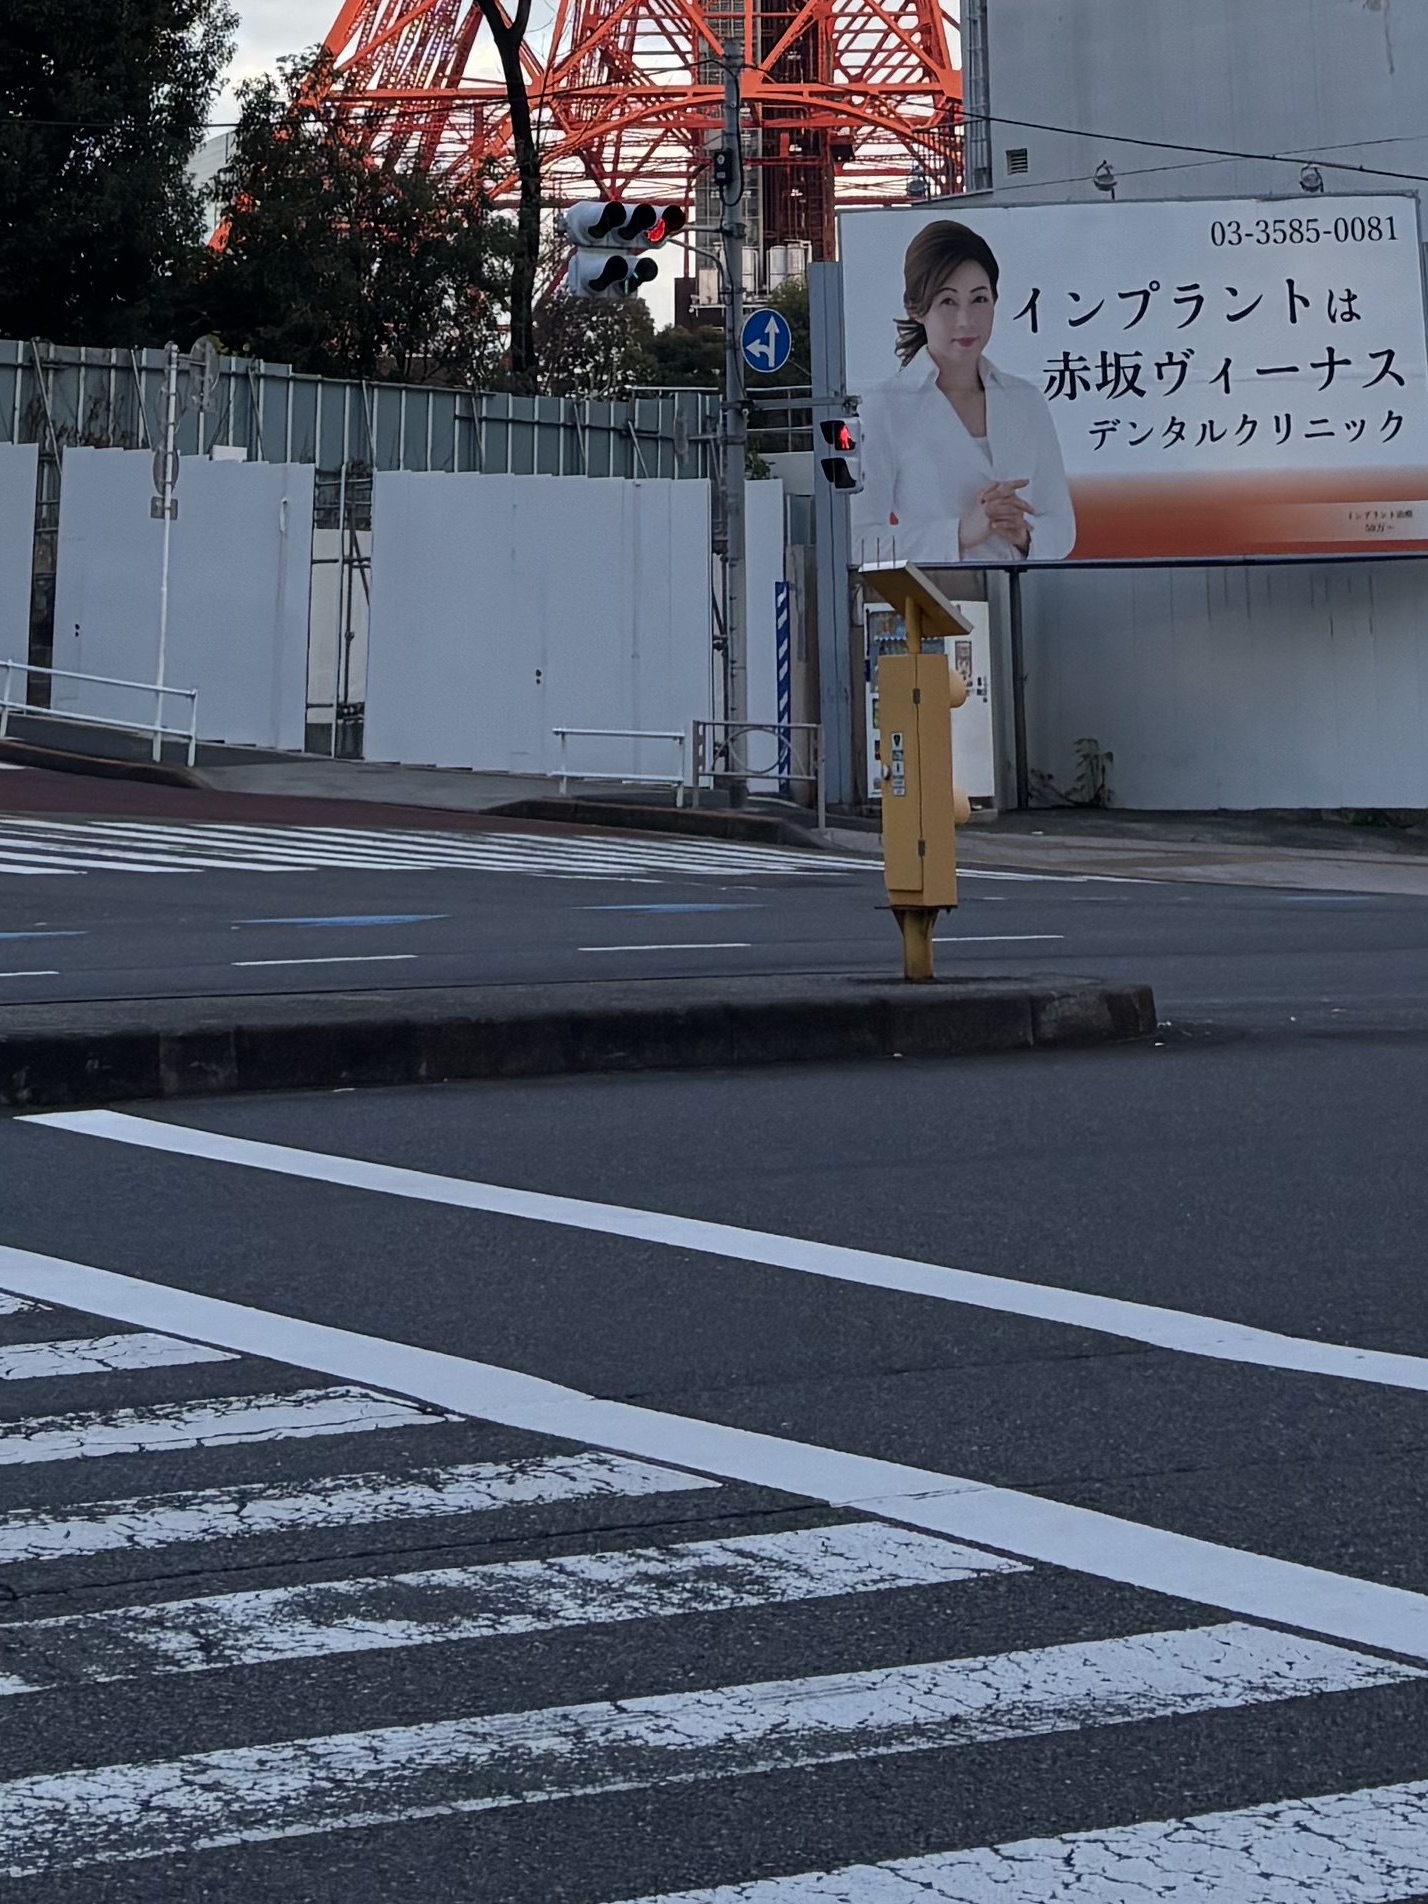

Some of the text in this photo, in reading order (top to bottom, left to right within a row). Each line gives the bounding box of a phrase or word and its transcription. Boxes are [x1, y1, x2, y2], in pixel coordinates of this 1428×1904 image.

[1210, 215, 1400, 247] 03-3585-0081
[1012, 277, 1363, 334] インプラントは
[1042, 346, 1406, 402] 赤坂ヴィーナス
[1088, 409, 1405, 452] デンタルクリニック
